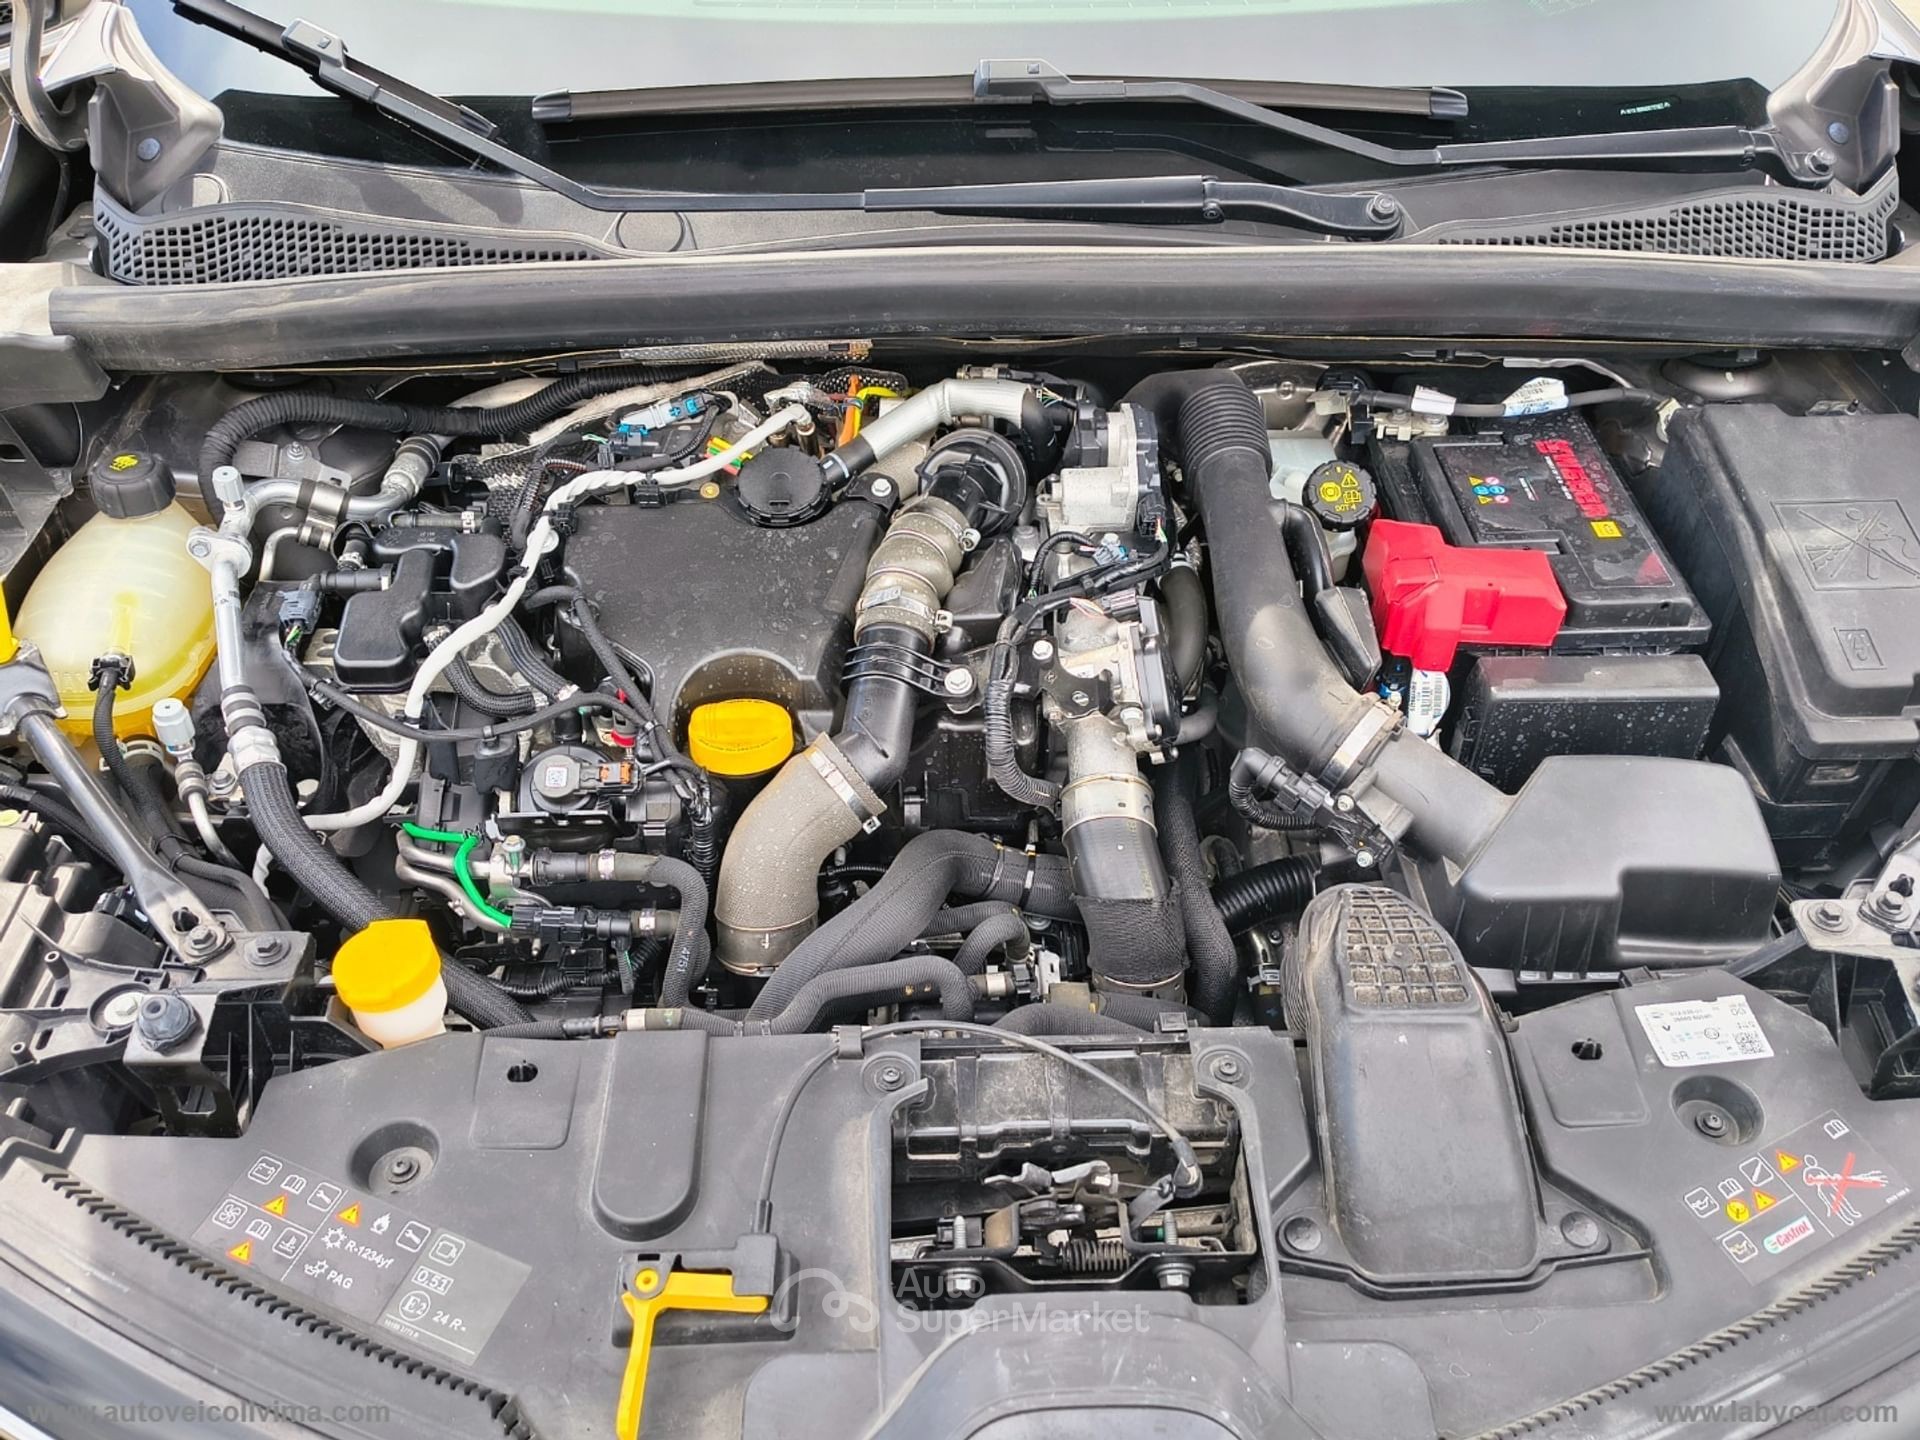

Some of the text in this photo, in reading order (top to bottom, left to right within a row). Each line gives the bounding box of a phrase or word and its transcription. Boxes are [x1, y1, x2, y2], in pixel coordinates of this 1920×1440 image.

[1775, 1219, 1810, 1247] Castrol
[344, 1239, 394, 1269] R-1234yf
[326, 1269, 353, 1290] PAG
[432, 1310, 447, 1326] 24
